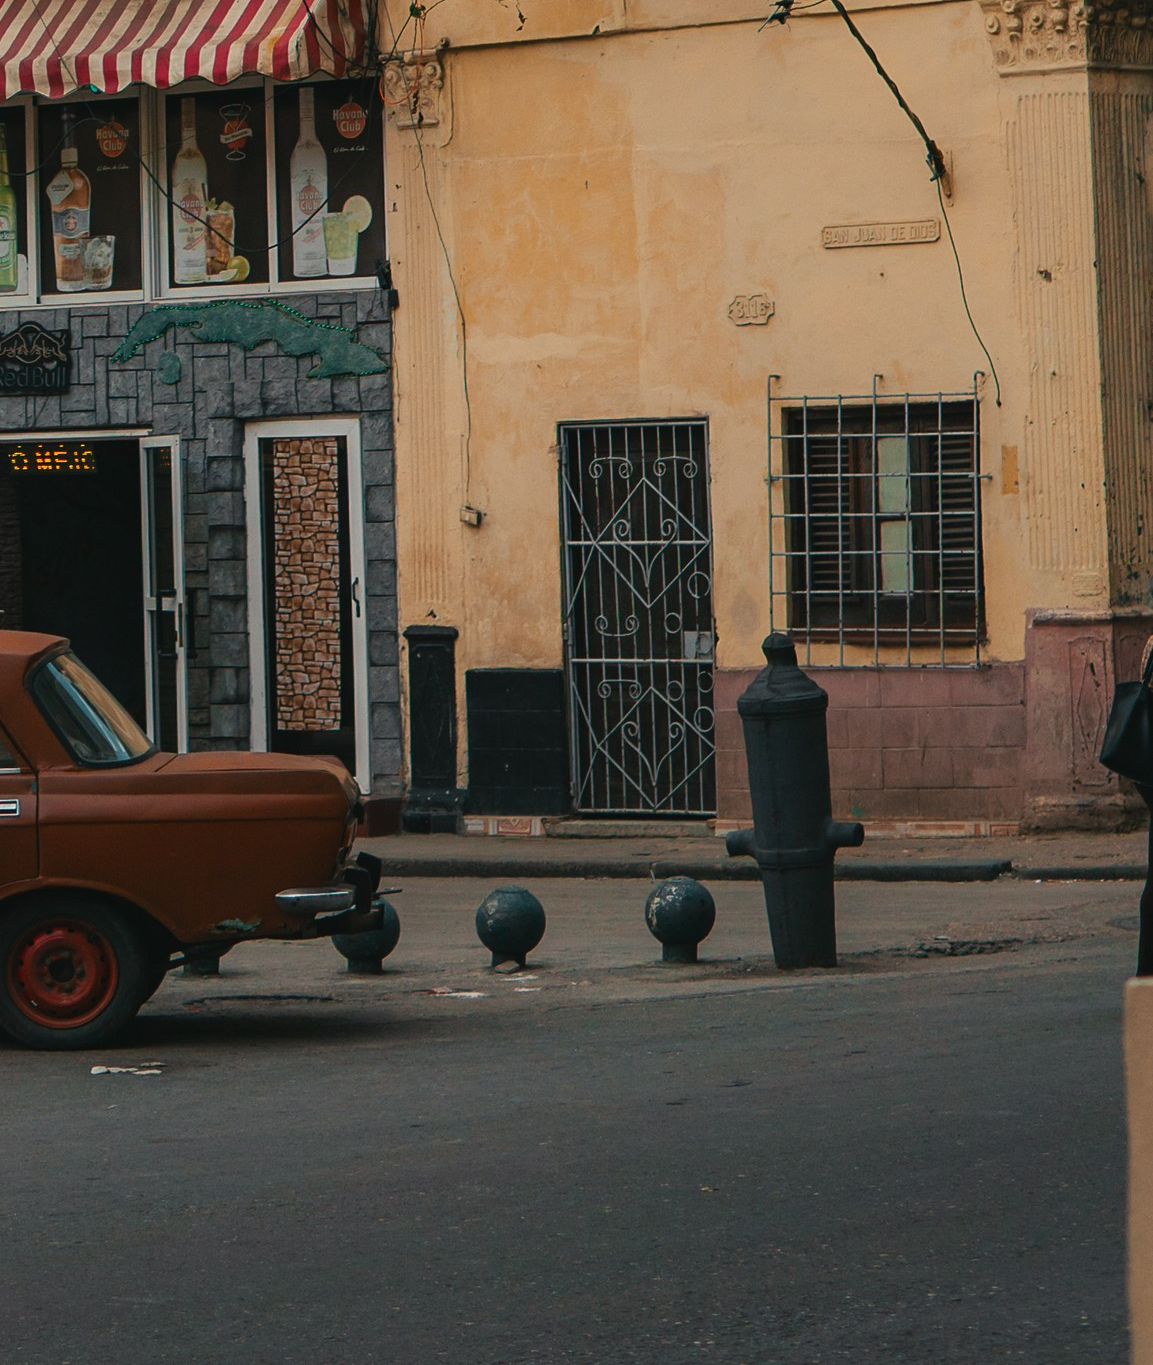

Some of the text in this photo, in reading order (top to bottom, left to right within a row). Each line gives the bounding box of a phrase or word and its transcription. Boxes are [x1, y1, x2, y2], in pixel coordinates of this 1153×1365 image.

[340, 120, 361, 132] Club
[103, 140, 122, 151] Club
[824, 222, 937, 245] SAN JUAN DE DIOS
[33, 366, 65, 387] Bull
